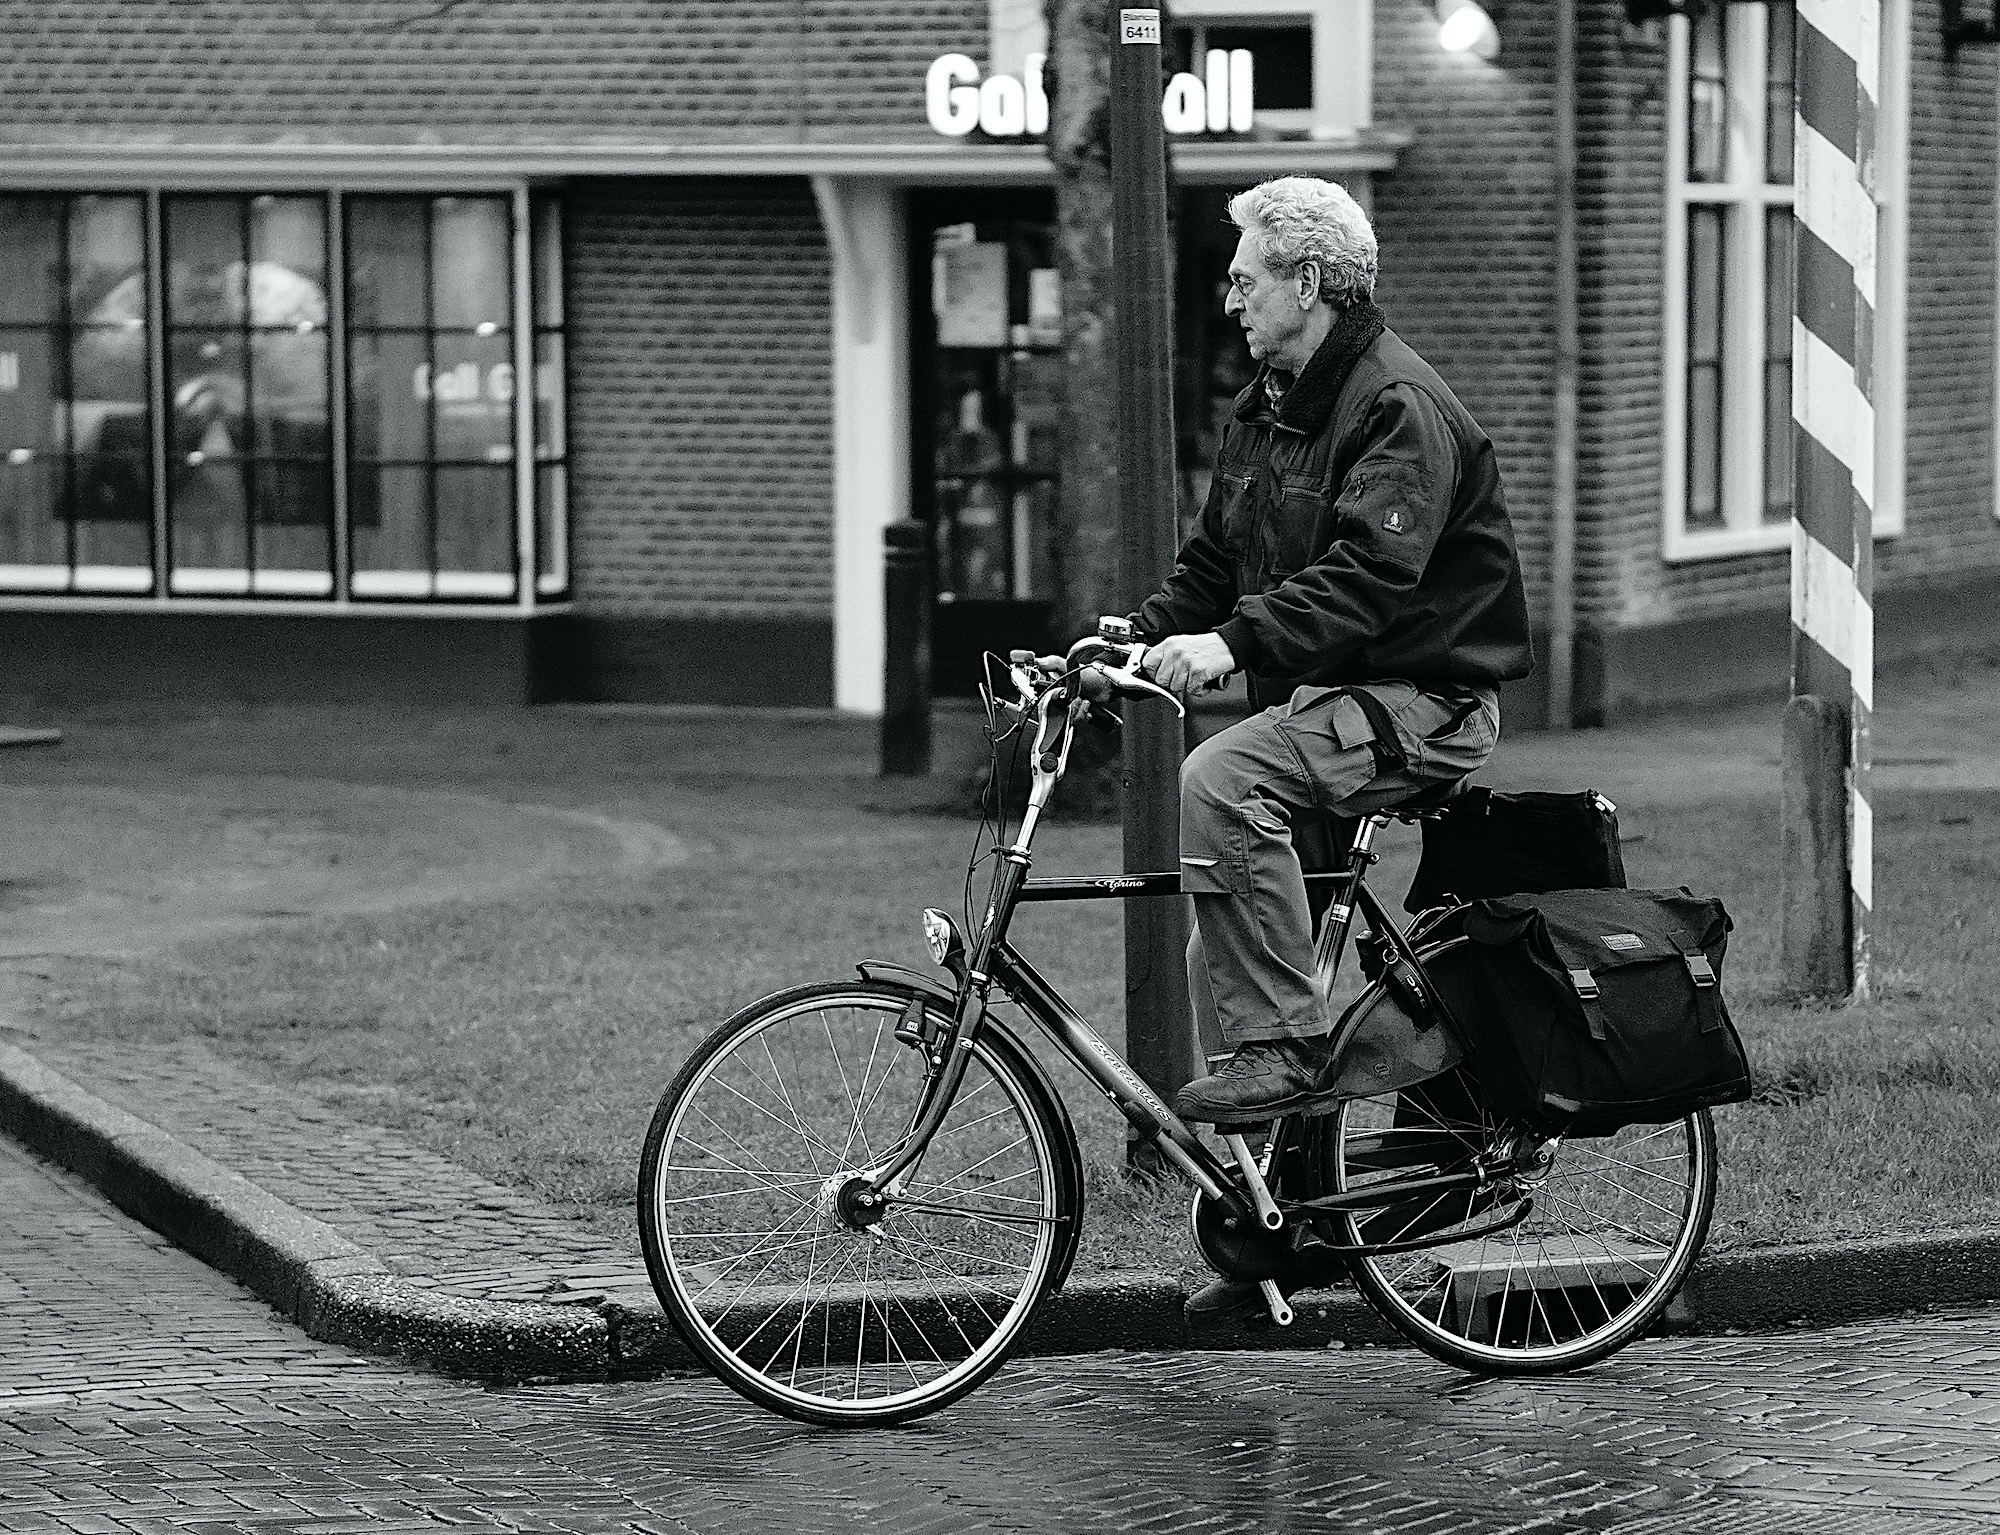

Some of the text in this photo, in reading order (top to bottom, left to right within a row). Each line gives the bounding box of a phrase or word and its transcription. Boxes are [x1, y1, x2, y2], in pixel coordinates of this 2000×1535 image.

[1126, 26, 1157, 38] 6411
[926, 49, 1254, 136] Gal all
[1089, 1039, 1172, 1121] Batavus
